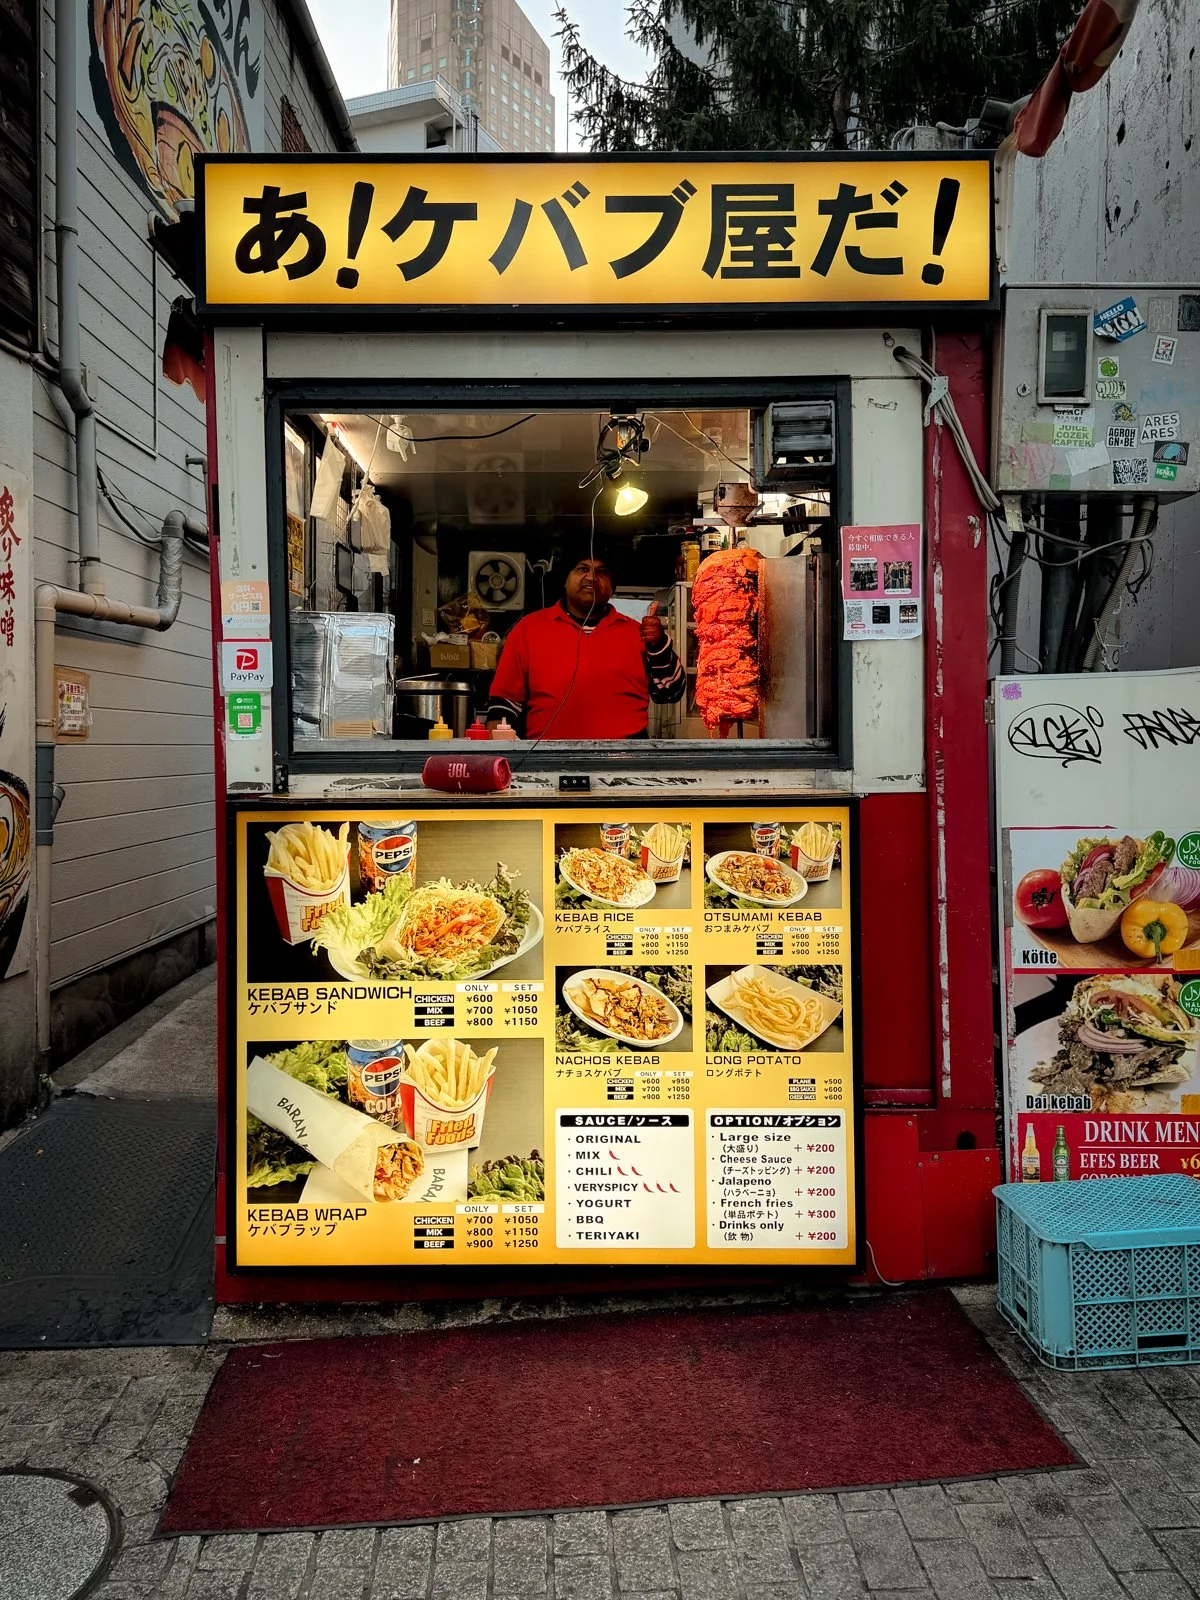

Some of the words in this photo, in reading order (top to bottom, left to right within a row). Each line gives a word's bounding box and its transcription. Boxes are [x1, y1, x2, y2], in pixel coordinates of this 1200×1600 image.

[235, 177, 960, 289] あ!ケバブ屋だ!
[1099, 304, 1124, 321] HELLO
[1145, 414, 1178, 428] ARES
[1109, 428, 1136, 438] AGROH
[1142, 427, 1175, 440] ARES
[230, 673, 265, 682] PayPay
[448, 763, 470, 778] JBL
[375, 846, 413, 860] PEPSI
[555, 913, 599, 922] KEBAB
[603, 913, 634, 922] RICE
[704, 912, 773, 921] OTSUMAMI
[778, 912, 822, 921] KEBAB
[556, 925, 611, 934] ケバブライス
[704, 924, 770, 933] おつまみケバブ
[1022, 949, 1057, 964] Köfte
[247, 988, 309, 1001] KEBAB
[316, 986, 412, 1000] SANDWICH
[415, 995, 454, 1003] CHICKEN
[466, 994, 493, 1003] ¥600
[511, 994, 538, 1003] ¥950
[248, 1001, 338, 1015] ケバブサンド
[466, 1006, 493, 1015] ¥700
[504, 1006, 538, 1014] ¥1050
[466, 1018, 493, 1026] ¥800
[504, 1018, 538, 1026] ¥1150
[555, 1056, 611, 1065] NACHOS
[616, 1056, 660, 1065] KEBAB
[705, 1056, 742, 1065] LONG
[747, 1056, 801, 1065] POTATO
[556, 1069, 622, 1077] ナチョスケバブ
[706, 1069, 762, 1077] ロングポテト
[1026, 1095, 1047, 1110] Dai
[1051, 1095, 1091, 1110] kebab
[277, 1097, 307, 1139] BARAN
[575, 1116, 672, 1126] SAUCE/ソース
[714, 1116, 838, 1126] OPTION/オプション
[431, 1113, 475, 1134] Fried
[426, 1127, 475, 1146] Foods
[1084, 1121, 1150, 1143] DRINK
[576, 1135, 641, 1143] ORIGINAL
[720, 1133, 759, 1143] Large
[764, 1133, 791, 1141] size
[722, 1144, 759, 1153] (大盛り)
[807, 1144, 835, 1152] ¥200
[576, 1151, 600, 1159] MIX
[720, 1155, 757, 1163] Cheese
[761, 1155, 792, 1163] Sauce
[1080, 1153, 1116, 1169] EFES
[1120, 1153, 1160, 1169] BEER
[1180, 1153, 1200, 1169] ¥6
[576, 1167, 612, 1175] CHILI
[723, 1166, 791, 1175] (チーズトッピング)
[807, 1166, 835, 1175] ¥200
[719, 1177, 772, 1187] Jalapeno
[574, 1184, 638, 1192] VERYSPICY
[807, 1188, 835, 1197] ¥200
[576, 1200, 631, 1208] YOGURT
[721, 1199, 761, 1207] French
[766, 1199, 793, 1207] fries
[464, 1205, 489, 1213] ONLY
[514, 1205, 533, 1213] SET
[247, 1209, 309, 1222] KEBAB
[315, 1208, 367, 1221] WRAP
[723, 1210, 779, 1219] (単品ポテト)
[808, 1210, 836, 1219] ¥300
[414, 1216, 454, 1224] CHICKEN
[466, 1216, 493, 1224] ¥700
[504, 1216, 538, 1224] ¥1050
[576, 1216, 604, 1224] BBQ
[248, 1223, 338, 1237] ケバブラップ
[719, 1221, 756, 1229] Drinks
[760, 1221, 784, 1231] only
[426, 1228, 443, 1236] MIX
[466, 1228, 493, 1236] ¥800
[504, 1228, 538, 1236] ¥1150
[576, 1232, 640, 1240] TERIYAKI
[808, 1232, 836, 1241] ¥200
[423, 1240, 445, 1248] BEEF
[466, 1239, 493, 1248] ¥900
[504, 1239, 538, 1248] ¥1250
